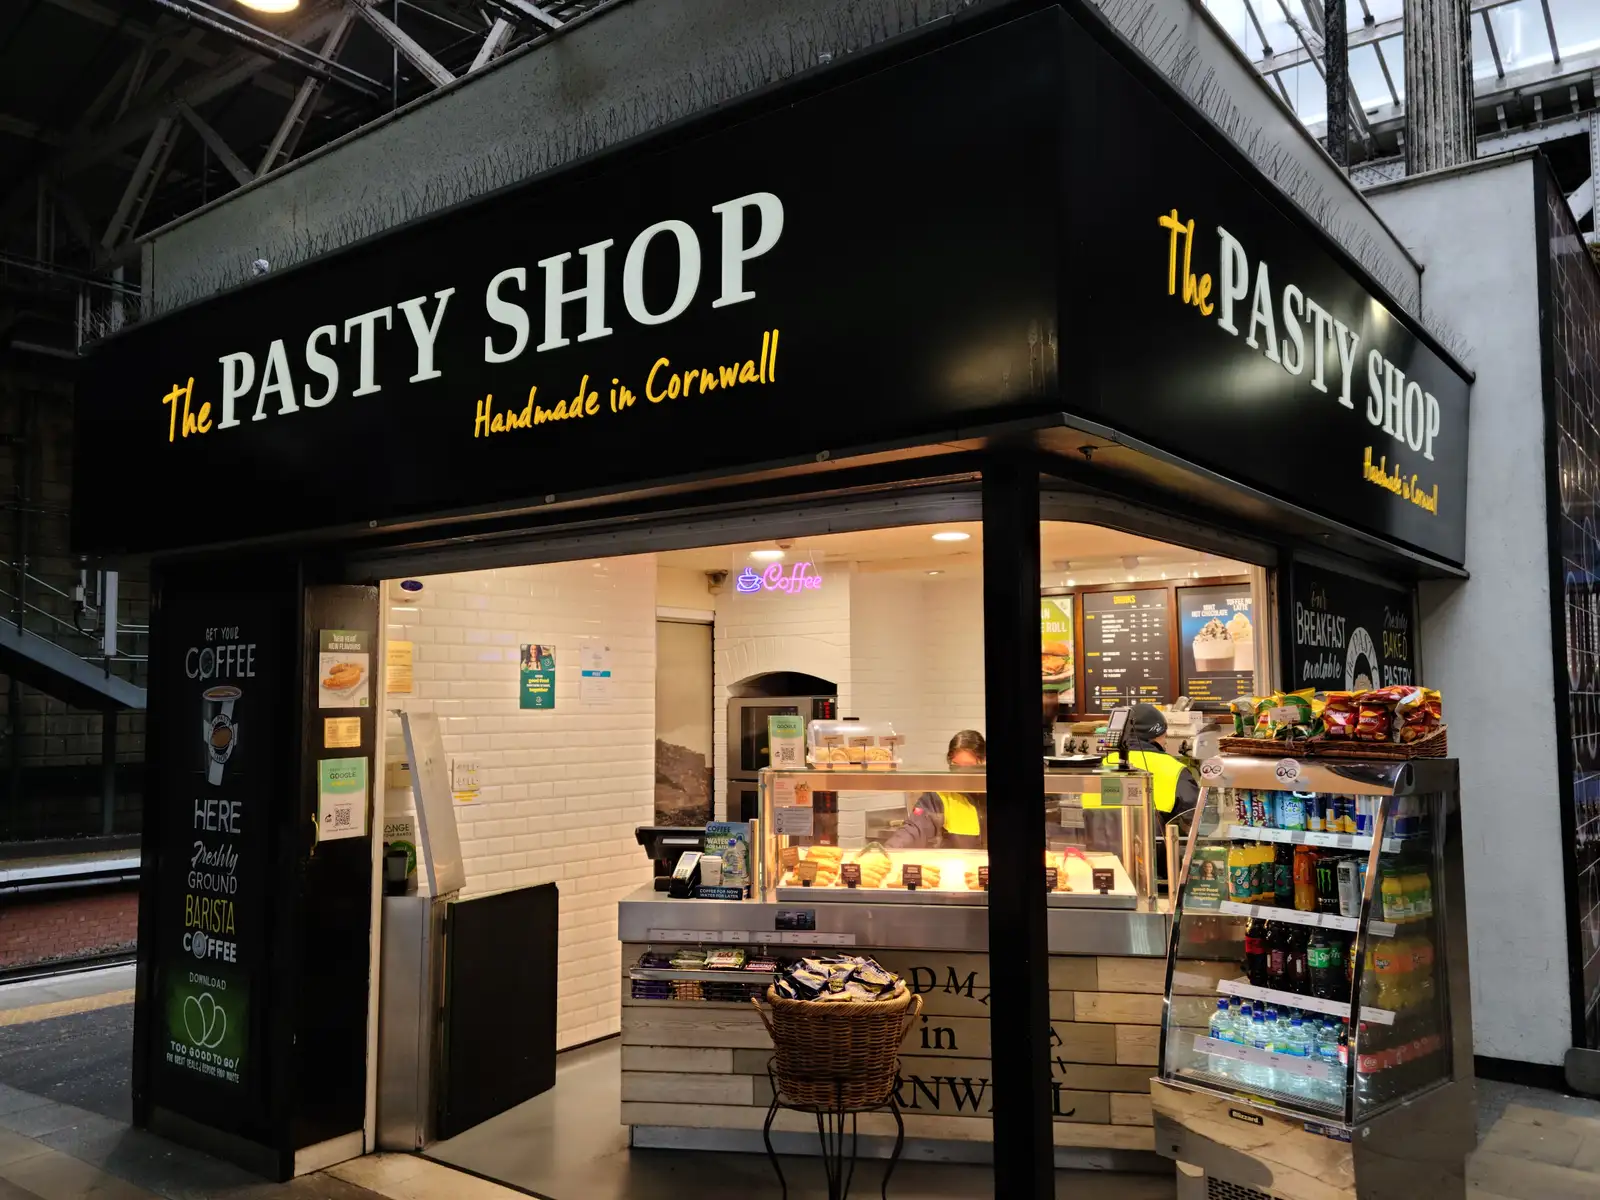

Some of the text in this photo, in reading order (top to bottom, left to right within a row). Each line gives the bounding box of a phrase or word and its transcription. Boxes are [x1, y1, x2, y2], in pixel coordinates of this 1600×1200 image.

[162, 191, 784, 443] The PASTY SHOP
[1158, 208, 1441, 461] The PASTY SHOP
[475, 329, 779, 438] Handmade in Cornwall
[763, 562, 822, 594] Coffee
[205, 625, 240, 642] GET YOUR
[1046, 621, 1068, 633] ROLL
[1296, 601, 1346, 649] BREAKFAST
[1382, 629, 1409, 661] BAKED
[185, 643, 257, 681] COFFEE
[1302, 652, 1343, 682] available
[1383, 664, 1412, 687] PASTRY
[329, 771, 357, 781] GOOGLE
[193, 798, 242, 834] HERE
[707, 825, 731, 833] COFFEE
[190, 840, 240, 876] Freshly
[187, 870, 238, 895] GROUND
[184, 894, 236, 936] BARISTA
[182, 930, 238, 964] COFFEE
[188, 971, 227, 991] DOWNLOAD
[920, 1015, 959, 1051] in
[169, 1040, 187, 1055] TOO
[188, 1047, 212, 1062] GOOD
[212, 1053, 223, 1066] TO
